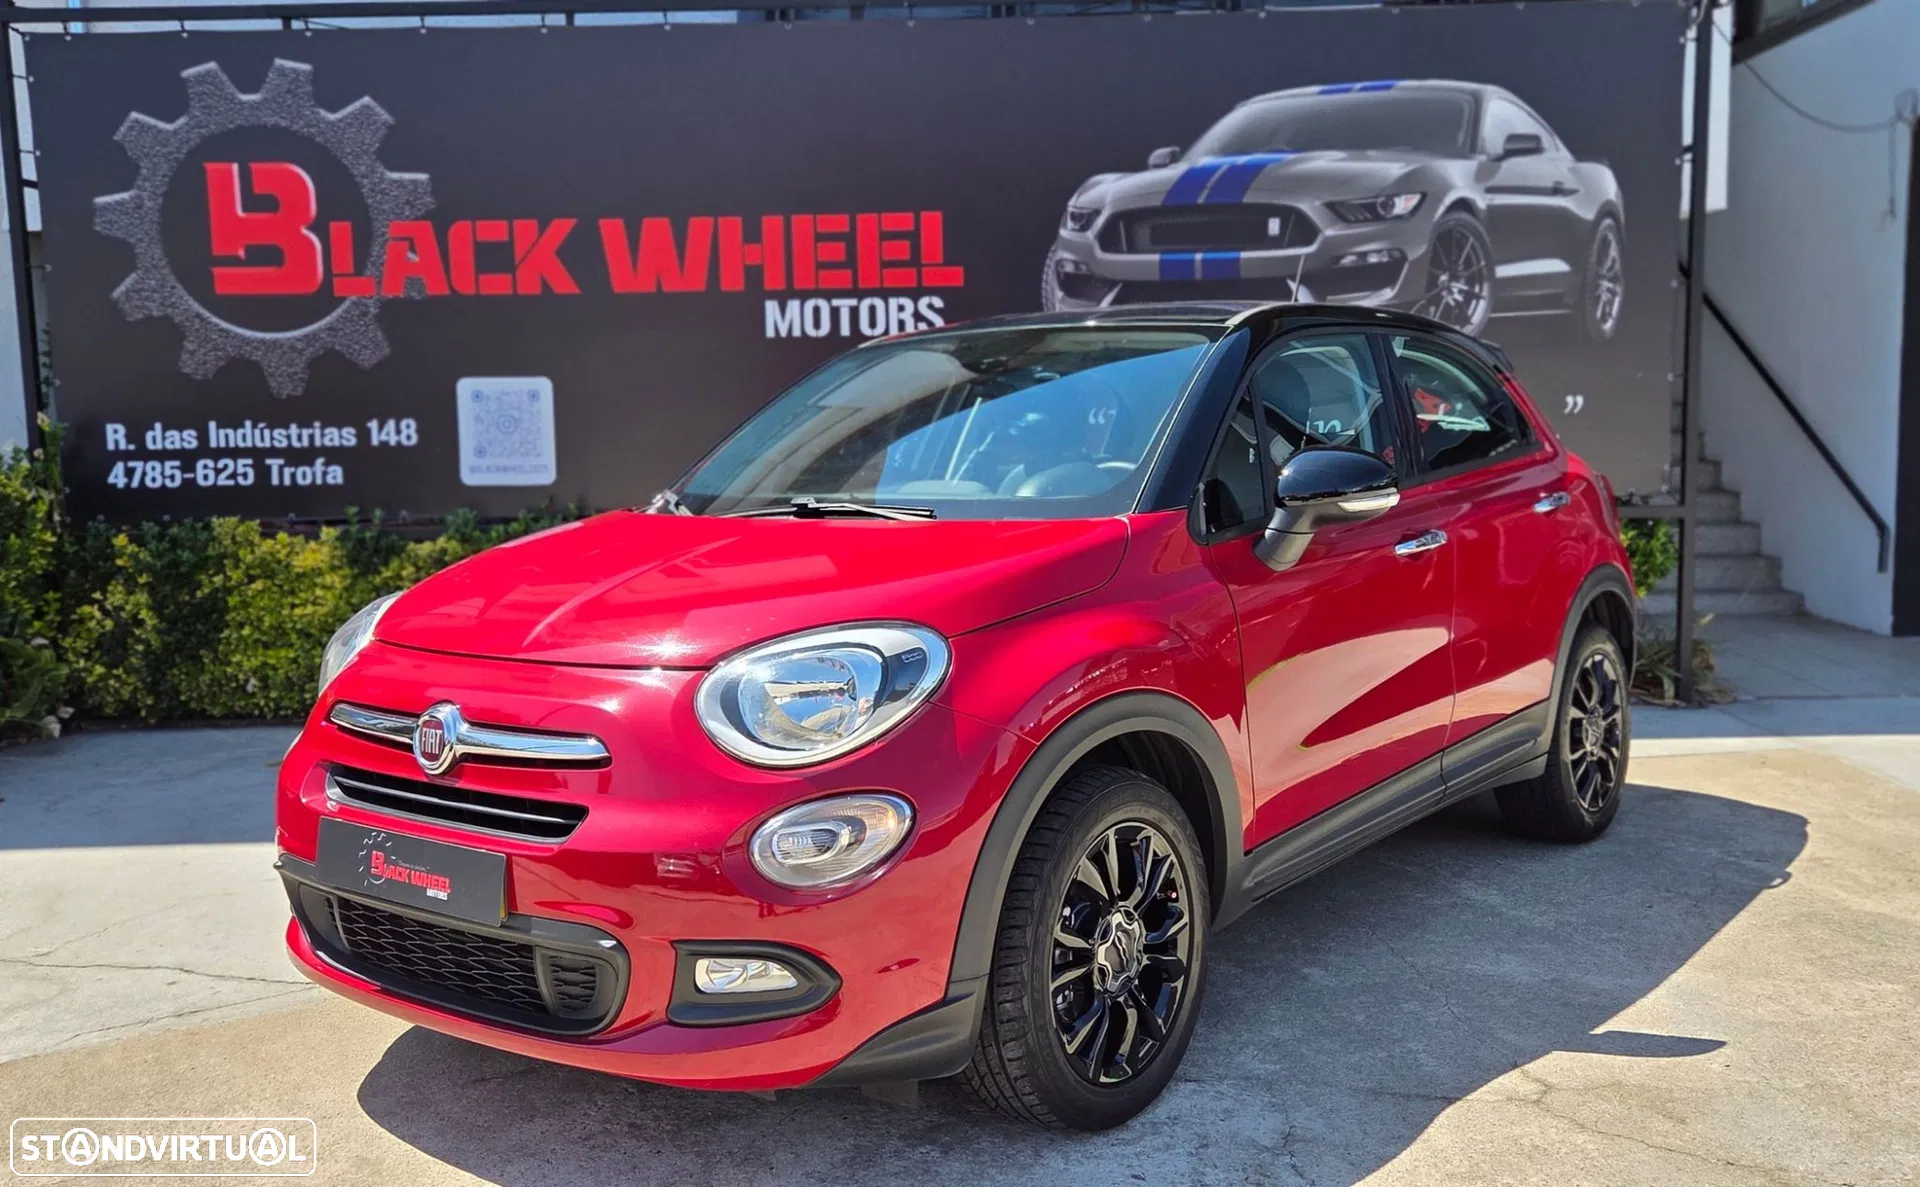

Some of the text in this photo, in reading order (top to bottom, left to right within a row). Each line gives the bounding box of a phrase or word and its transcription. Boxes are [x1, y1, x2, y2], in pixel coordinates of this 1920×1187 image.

[203, 162, 965, 297] BLACK WHEEL
[764, 296, 945, 338] MOTORS
[105, 418, 419, 451] R. das Indústrias 148
[107, 457, 344, 489] 4785-625 Trofa
[421, 727, 443, 755] FIAT
[370, 850, 409, 884] BLACK
[410, 870, 452, 893] WHEEL
